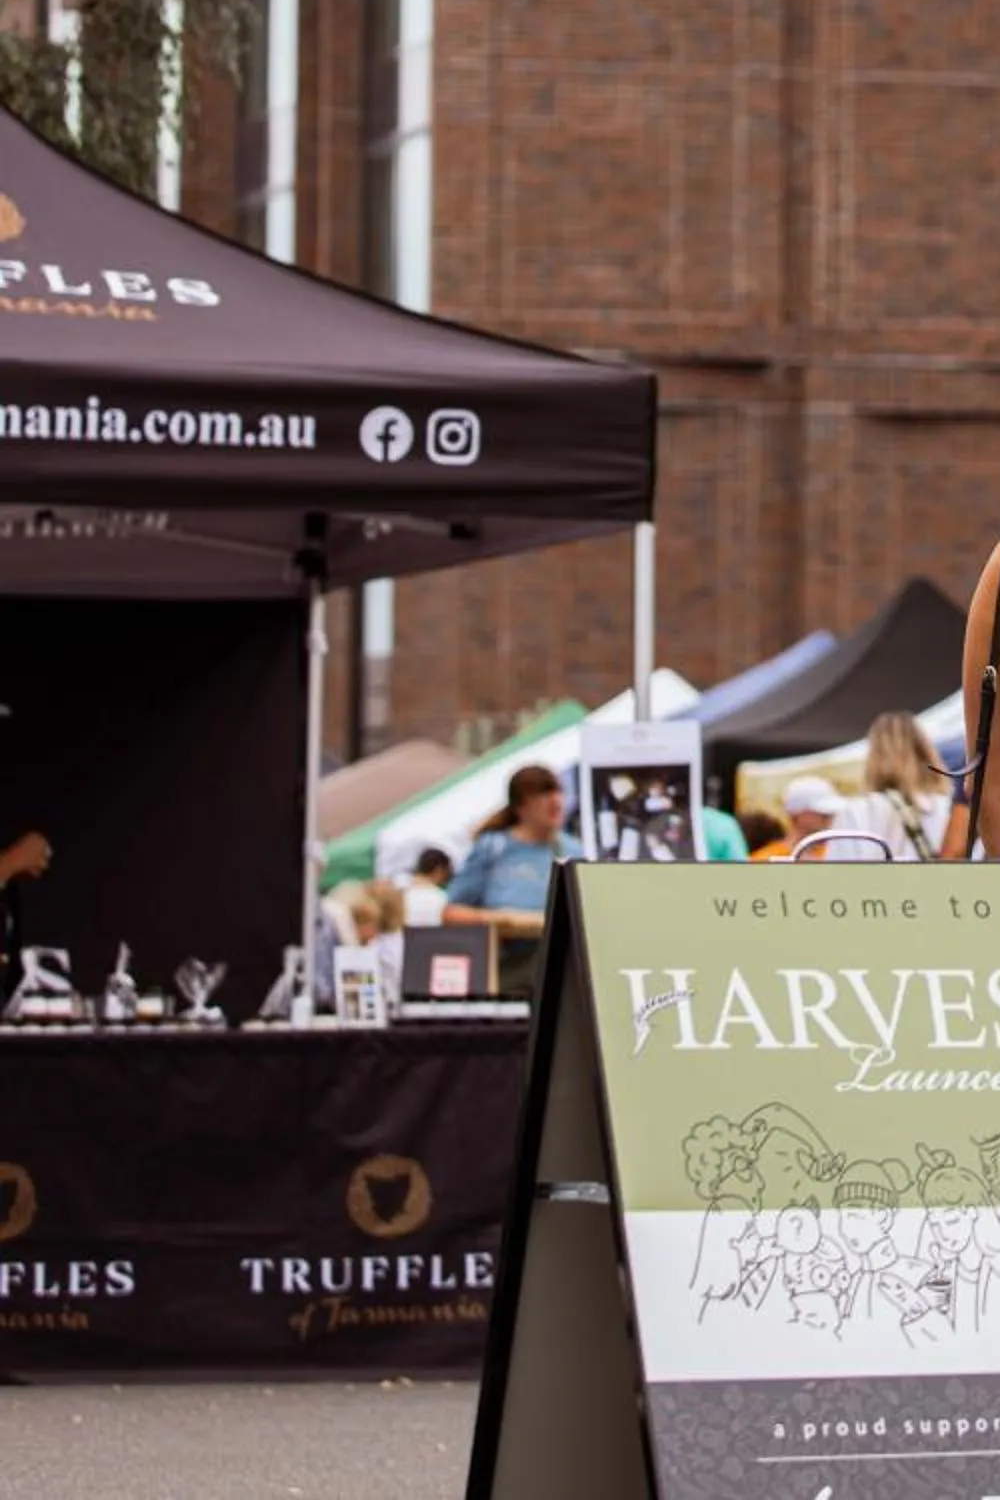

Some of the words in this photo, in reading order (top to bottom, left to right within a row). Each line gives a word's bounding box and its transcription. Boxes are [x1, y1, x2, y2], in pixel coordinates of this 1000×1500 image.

[713, 891, 919, 920] welcome
[951, 894, 992, 920] to
[239, 1252, 496, 1294] TRUFFLE
[773, 1421, 786, 1439] a
[803, 1417, 888, 1442] proud
